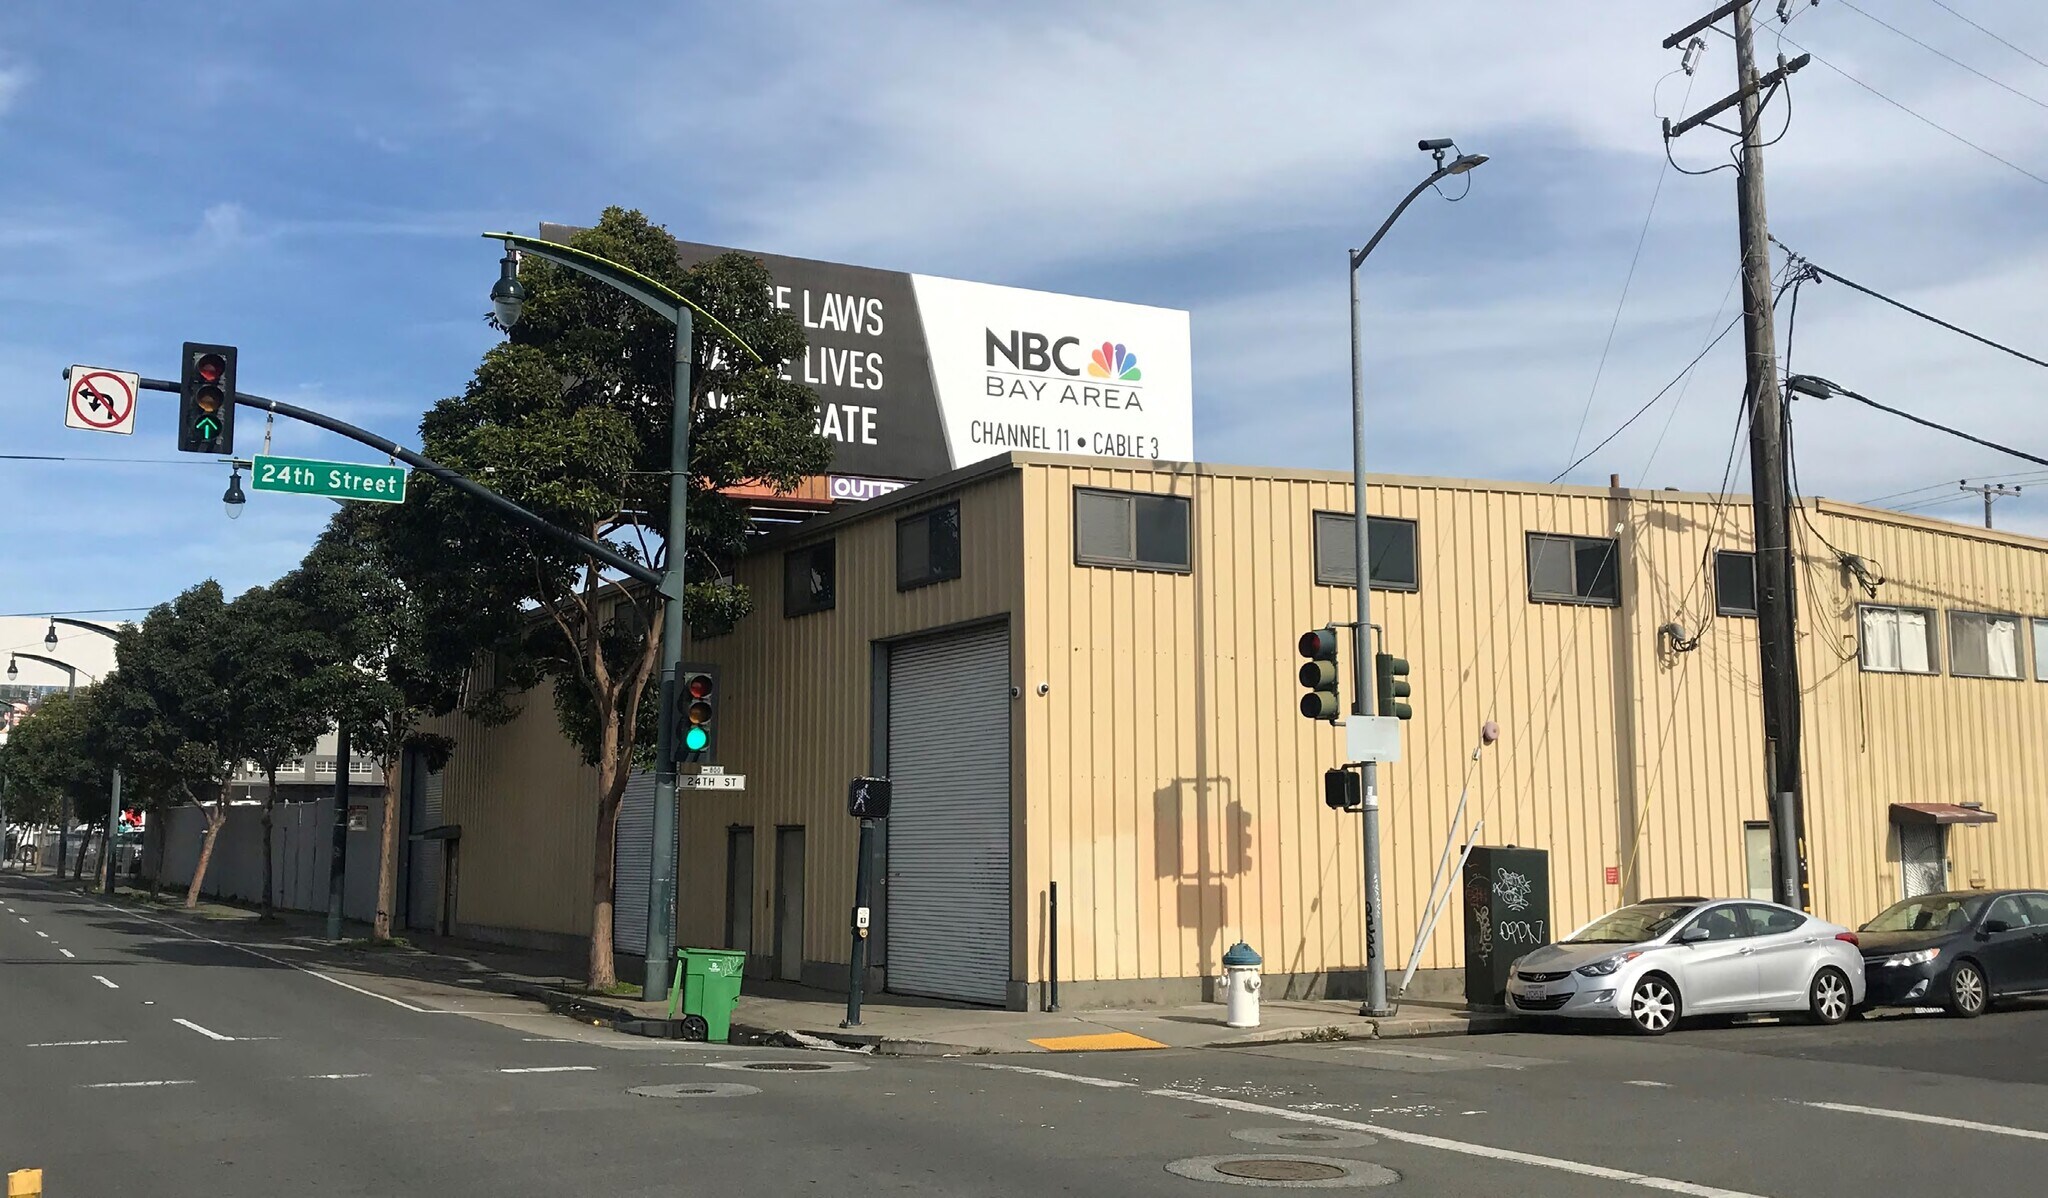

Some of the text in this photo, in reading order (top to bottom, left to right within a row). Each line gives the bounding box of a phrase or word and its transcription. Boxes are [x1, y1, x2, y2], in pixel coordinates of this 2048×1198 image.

[803, 289, 884, 336] LAWS
[804, 345, 884, 390] LIVES
[985, 326, 1080, 376] NBC
[986, 375, 1143, 412] BAY AREA
[971, 419, 1159, 459] CHANNEL 11 CABLE 3
[261, 463, 397, 494] 24th Street
[687, 776, 737, 787] 24TH ST
